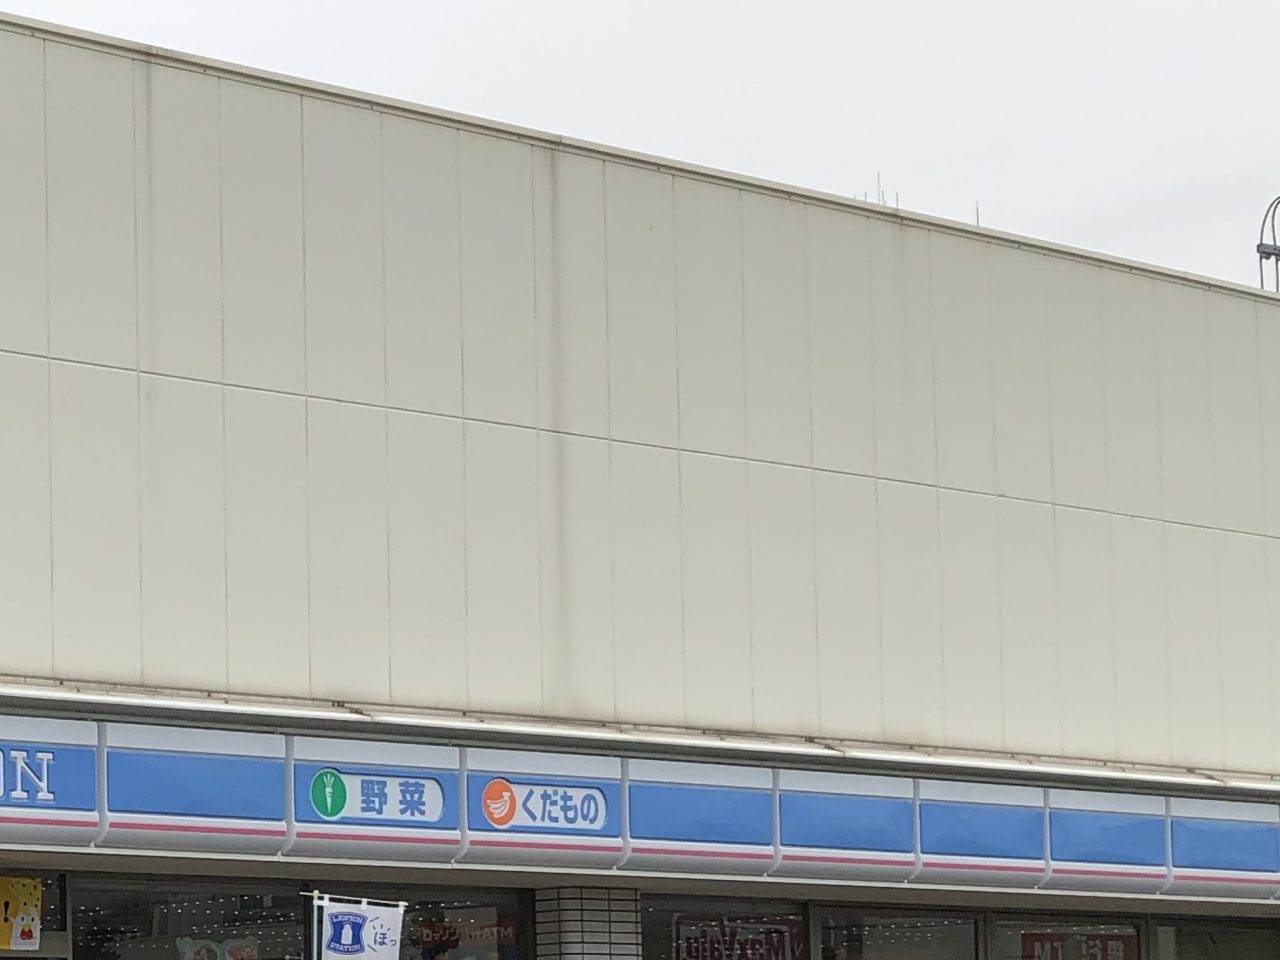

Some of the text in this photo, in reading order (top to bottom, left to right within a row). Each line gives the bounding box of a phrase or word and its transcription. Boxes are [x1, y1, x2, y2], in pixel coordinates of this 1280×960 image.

[360, 778, 427, 817] 野菜
[522, 788, 599, 825] くだもの
